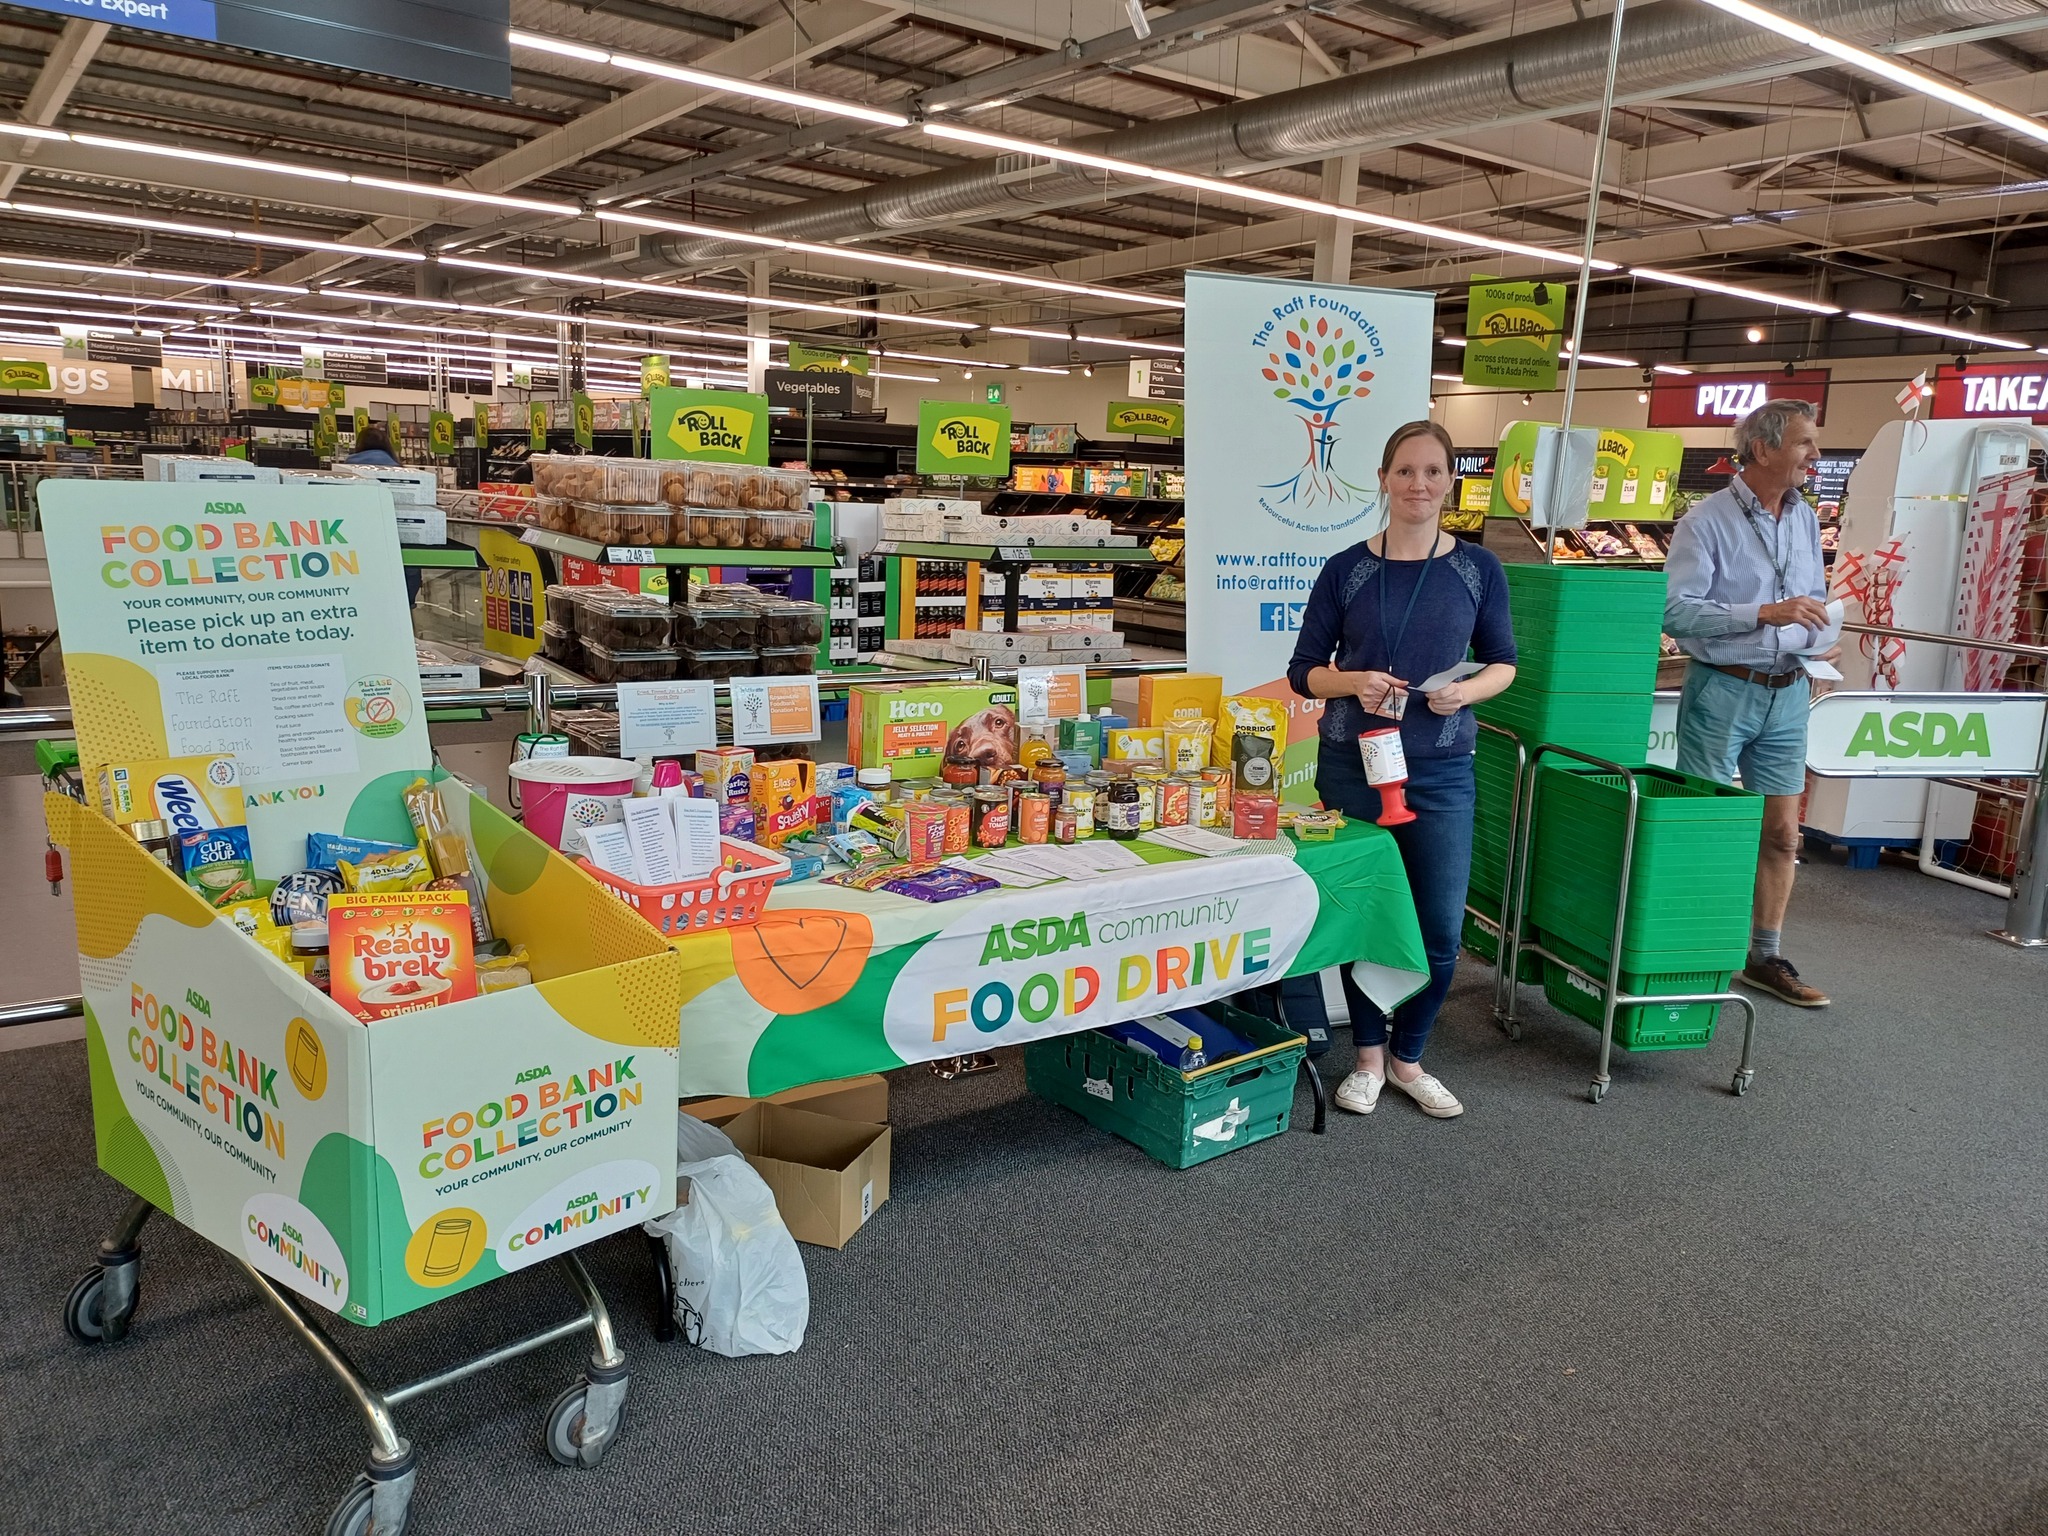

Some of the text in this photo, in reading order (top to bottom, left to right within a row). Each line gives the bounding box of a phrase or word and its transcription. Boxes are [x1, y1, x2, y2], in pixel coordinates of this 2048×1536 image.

[1485, 289, 1514, 300] 1000s of
[1252, 294, 1384, 358] The Raft Foundation
[64, 337, 85, 349] 24
[91, 353, 117, 361] Yogurts
[304, 357, 322, 369] 25
[1474, 354, 1551, 368] across stores and online.
[1153, 361, 1173, 371] Chicken
[1485, 365, 1539, 378] That's Asda Price.
[36, 364, 110, 395] ggs
[162, 367, 242, 398] Mil
[514, 374, 530, 386] 26
[1136, 370, 1142, 384] 1
[1152, 374, 1164, 383] Pork
[776, 380, 840, 394] Vegetables
[1152, 388, 1165, 396] Lamb
[1697, 383, 1768, 415] PIZZA
[687, 415, 728, 432] ROLL
[947, 424, 979, 440] ROLL
[1089, 473, 1127, 484] Refreshing
[1094, 483, 1112, 494] juicy
[204, 502, 247, 515] ASDA
[1259, 497, 1377, 533] Resourceful Action for Transformation
[101, 518, 349, 554] FOOD BANK
[568, 559, 584, 571] Father's
[1216, 552, 1328, 568] www.raftfoun
[101, 550, 361, 589] COLLECTION
[571, 571, 580, 580] Day
[598, 565, 616, 577] Father's
[1216, 575, 1316, 591] info@raftfou
[123, 586, 351, 611] YOUR COMMUNITY, OUR COMMUNITY
[127, 604, 358, 635] Please pick up an extra
[139, 624, 354, 655] item to donate today.
[358, 679, 392, 688] PLEASE
[176, 689, 240, 705] The Raft
[889, 700, 943, 718] Hero
[1174, 708, 1202, 718] CORN
[171, 714, 252, 731] Foundation
[910, 724, 939, 732] SELECTION
[1235, 724, 1276, 732] PORRIDGE
[1844, 711, 1992, 758] ASDA
[181, 737, 253, 754] Food Bank
[246, 784, 325, 809] ANK YOU
[728, 787, 749, 796] Rusks
[777, 802, 809, 830] Squishy
[201, 850, 235, 863] SOUP
[271, 887, 328, 916] BENT
[346, 893, 452, 905] BIG FAMILY PACK
[293, 910, 311, 918] STEAK
[978, 898, 1240, 967] ASDA community
[353, 931, 450, 959] Ready
[362, 954, 447, 981] brek
[932, 926, 1272, 1043] FOOD DRIVE
[185, 987, 212, 1019] ASDA
[380, 996, 439, 1018] original
[131, 981, 280, 1110] FOOD BANK
[515, 1065, 552, 1085] ASDA
[127, 1026, 286, 1160] COLLECTION
[422, 1055, 637, 1149] FOOD BANK
[135, 1079, 277, 1185] YOUR COMMUNITY, OUR COMMUNITY
[418, 1082, 643, 1180] COLLECTION
[435, 1118, 633, 1197] YOUR COMMUNITY, OUR COMMUNITY
[566, 1191, 599, 1211] ASDA
[508, 1185, 652, 1252] COMMUNITY
[282, 1221, 304, 1247] ASDA
[247, 1214, 342, 1297] COMMUNITY
